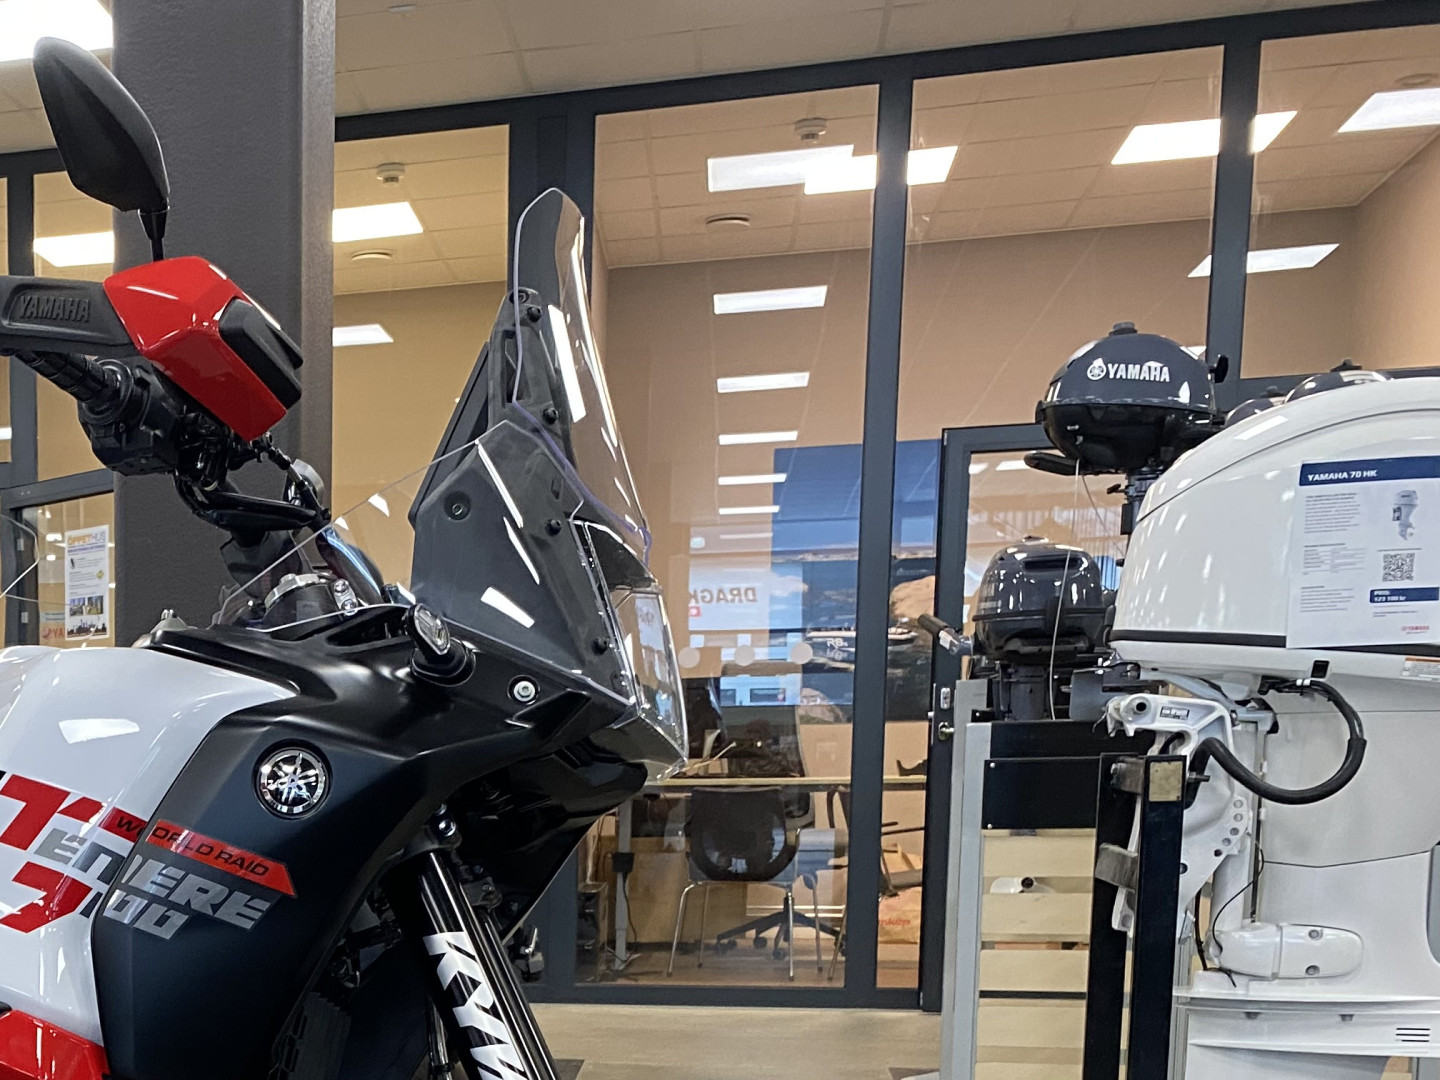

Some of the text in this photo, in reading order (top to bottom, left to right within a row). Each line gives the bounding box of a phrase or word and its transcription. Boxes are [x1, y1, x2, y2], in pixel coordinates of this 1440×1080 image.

[18, 296, 90, 322] YAMAHA
[1107, 362, 1170, 382] YAMAHA
[1307, 469, 1378, 481] YAMAHA 70 HK
[115, 814, 270, 877] WORLD RAID
